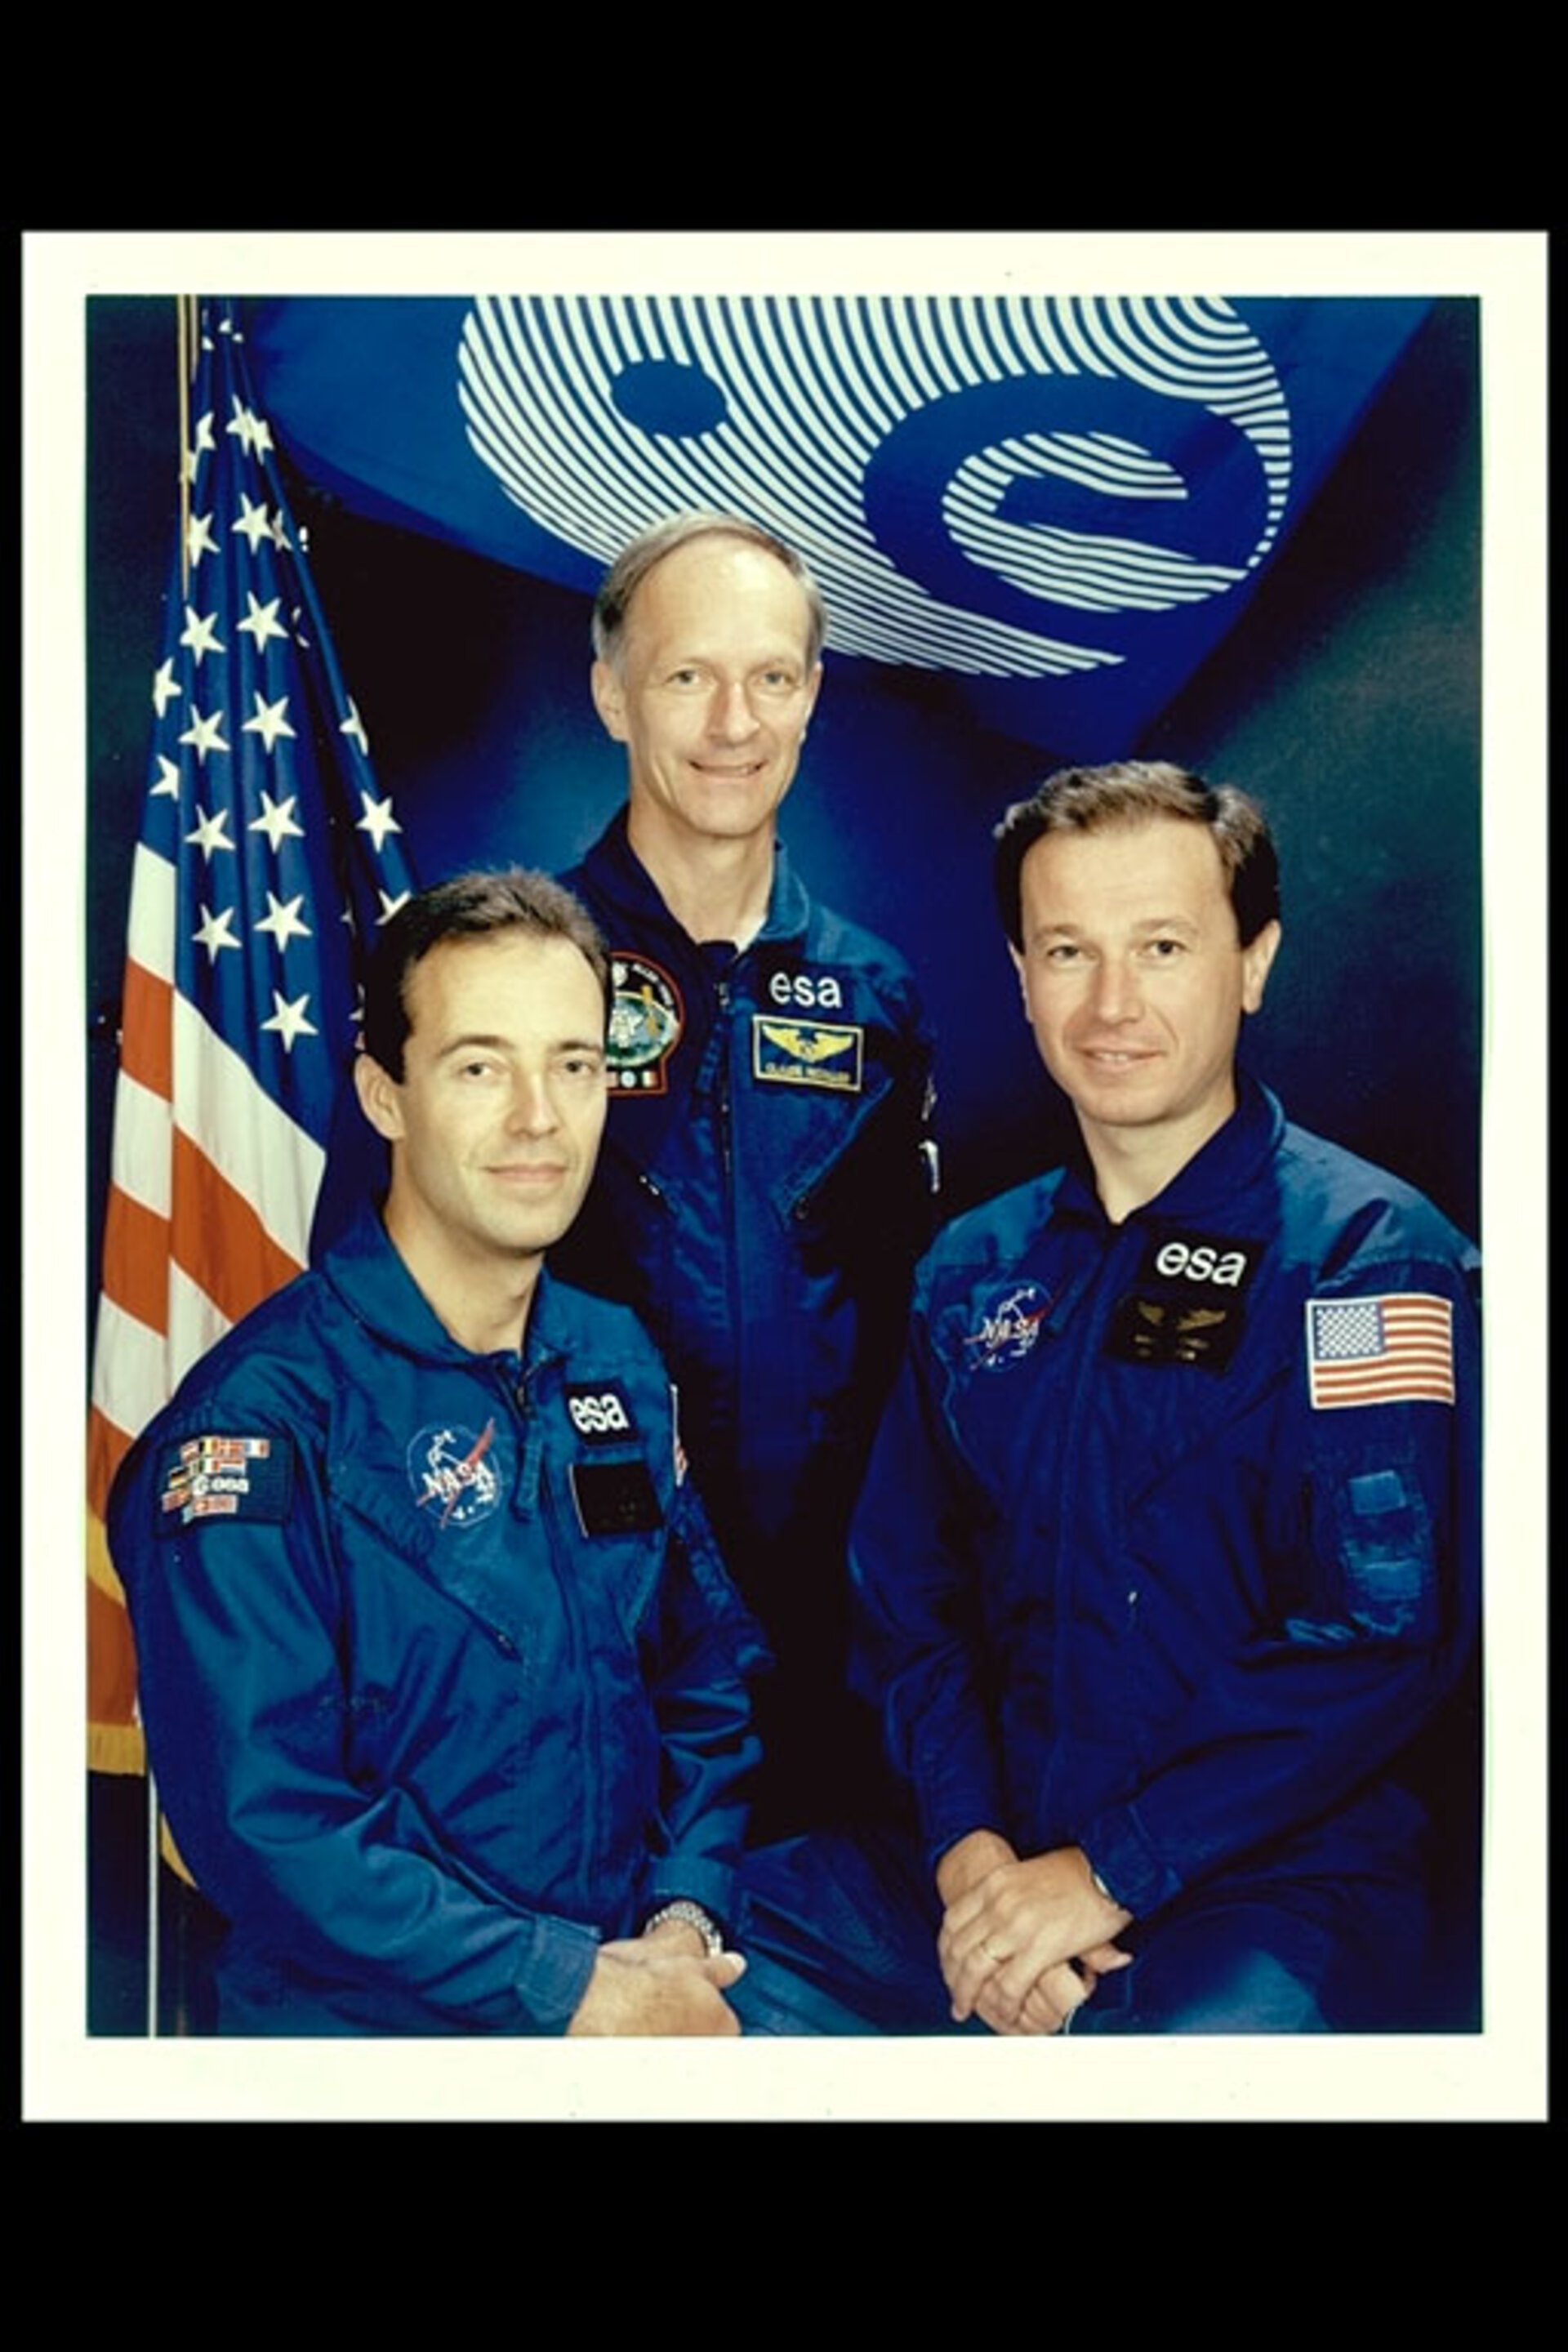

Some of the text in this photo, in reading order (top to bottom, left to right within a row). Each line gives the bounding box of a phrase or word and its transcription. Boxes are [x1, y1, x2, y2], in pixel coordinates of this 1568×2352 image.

[768, 972, 842, 1008] esa
[1156, 1242, 1247, 1287] esa
[569, 1393, 630, 1434] esa
[421, 1461, 495, 1503] NASA
